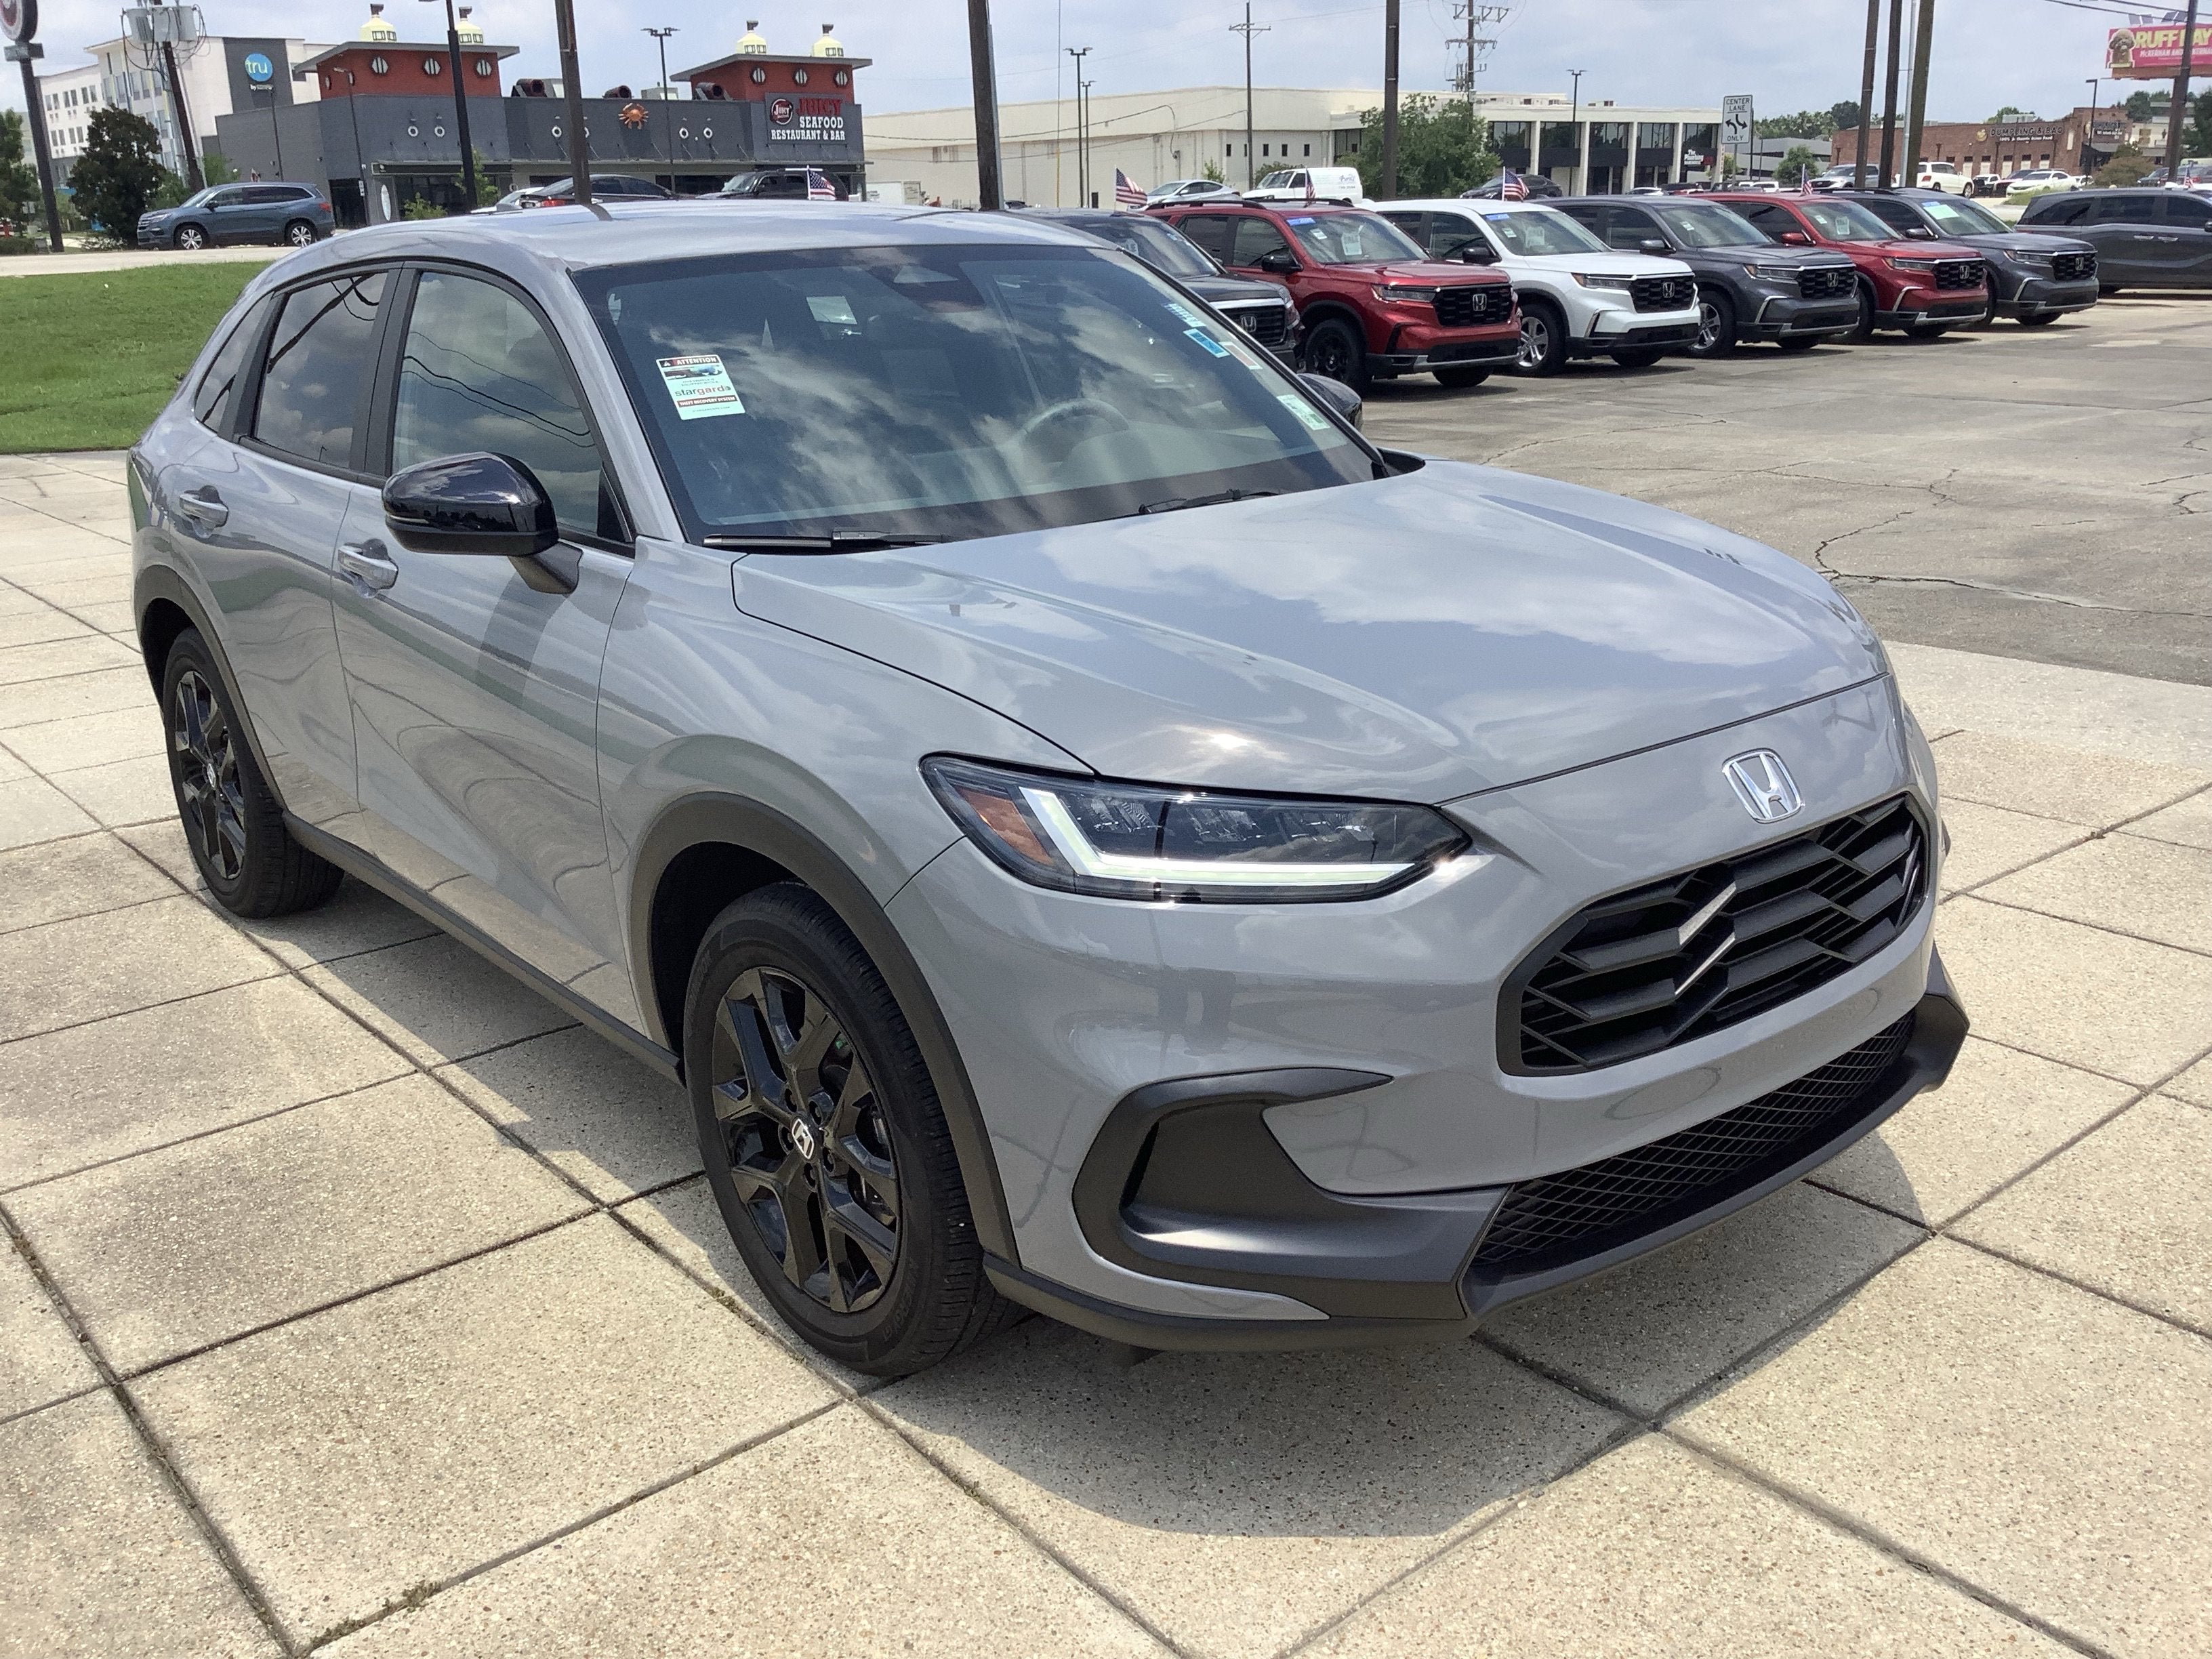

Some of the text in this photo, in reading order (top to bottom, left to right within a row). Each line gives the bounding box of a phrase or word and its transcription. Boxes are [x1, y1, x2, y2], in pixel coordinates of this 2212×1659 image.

[2135, 29, 2179, 48] RUFF
[245, 60, 268, 74] tru
[797, 97, 842, 115] JUICY
[799, 116, 844, 128] SEAFOOD
[771, 129, 846, 141] RESTAURANT & BAR
[1990, 127, 2034, 136] DUMPLING
[677, 357, 717, 366] ATTENTION
[675, 385, 725, 396] stargard
